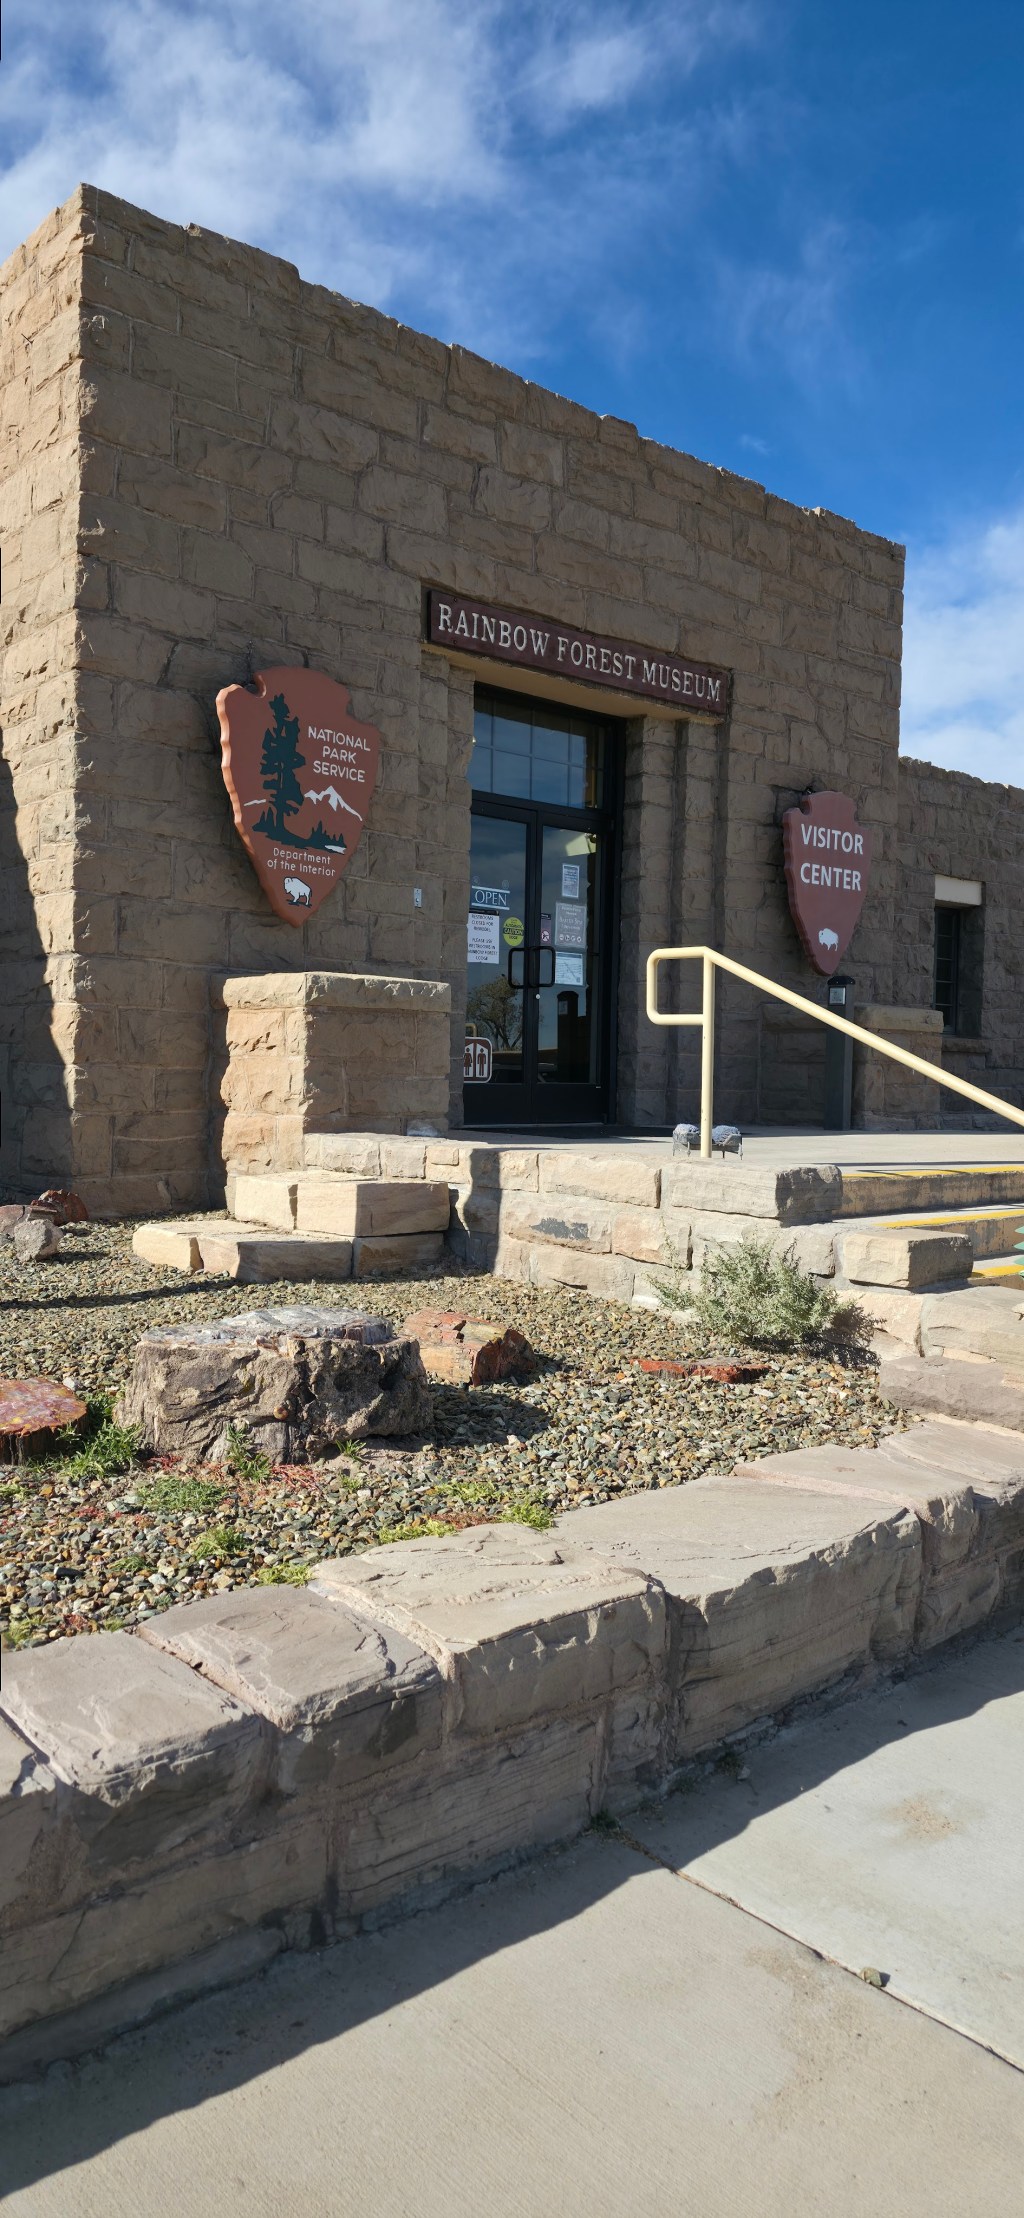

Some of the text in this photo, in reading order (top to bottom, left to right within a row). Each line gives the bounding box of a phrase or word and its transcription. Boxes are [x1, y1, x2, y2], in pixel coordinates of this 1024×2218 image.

[438, 603, 721, 702] RAINBOW FOREST MUSEUM
[308, 726, 371, 751] NATIONAL
[322, 746, 357, 764] PARK
[313, 760, 366, 783] SERVICE
[800, 823, 864, 855] VISITOR
[273, 847, 331, 865] Department
[267, 859, 336, 877] of the Interior
[800, 862, 862, 891] CENTER
[475, 889, 507, 906] OPEN
